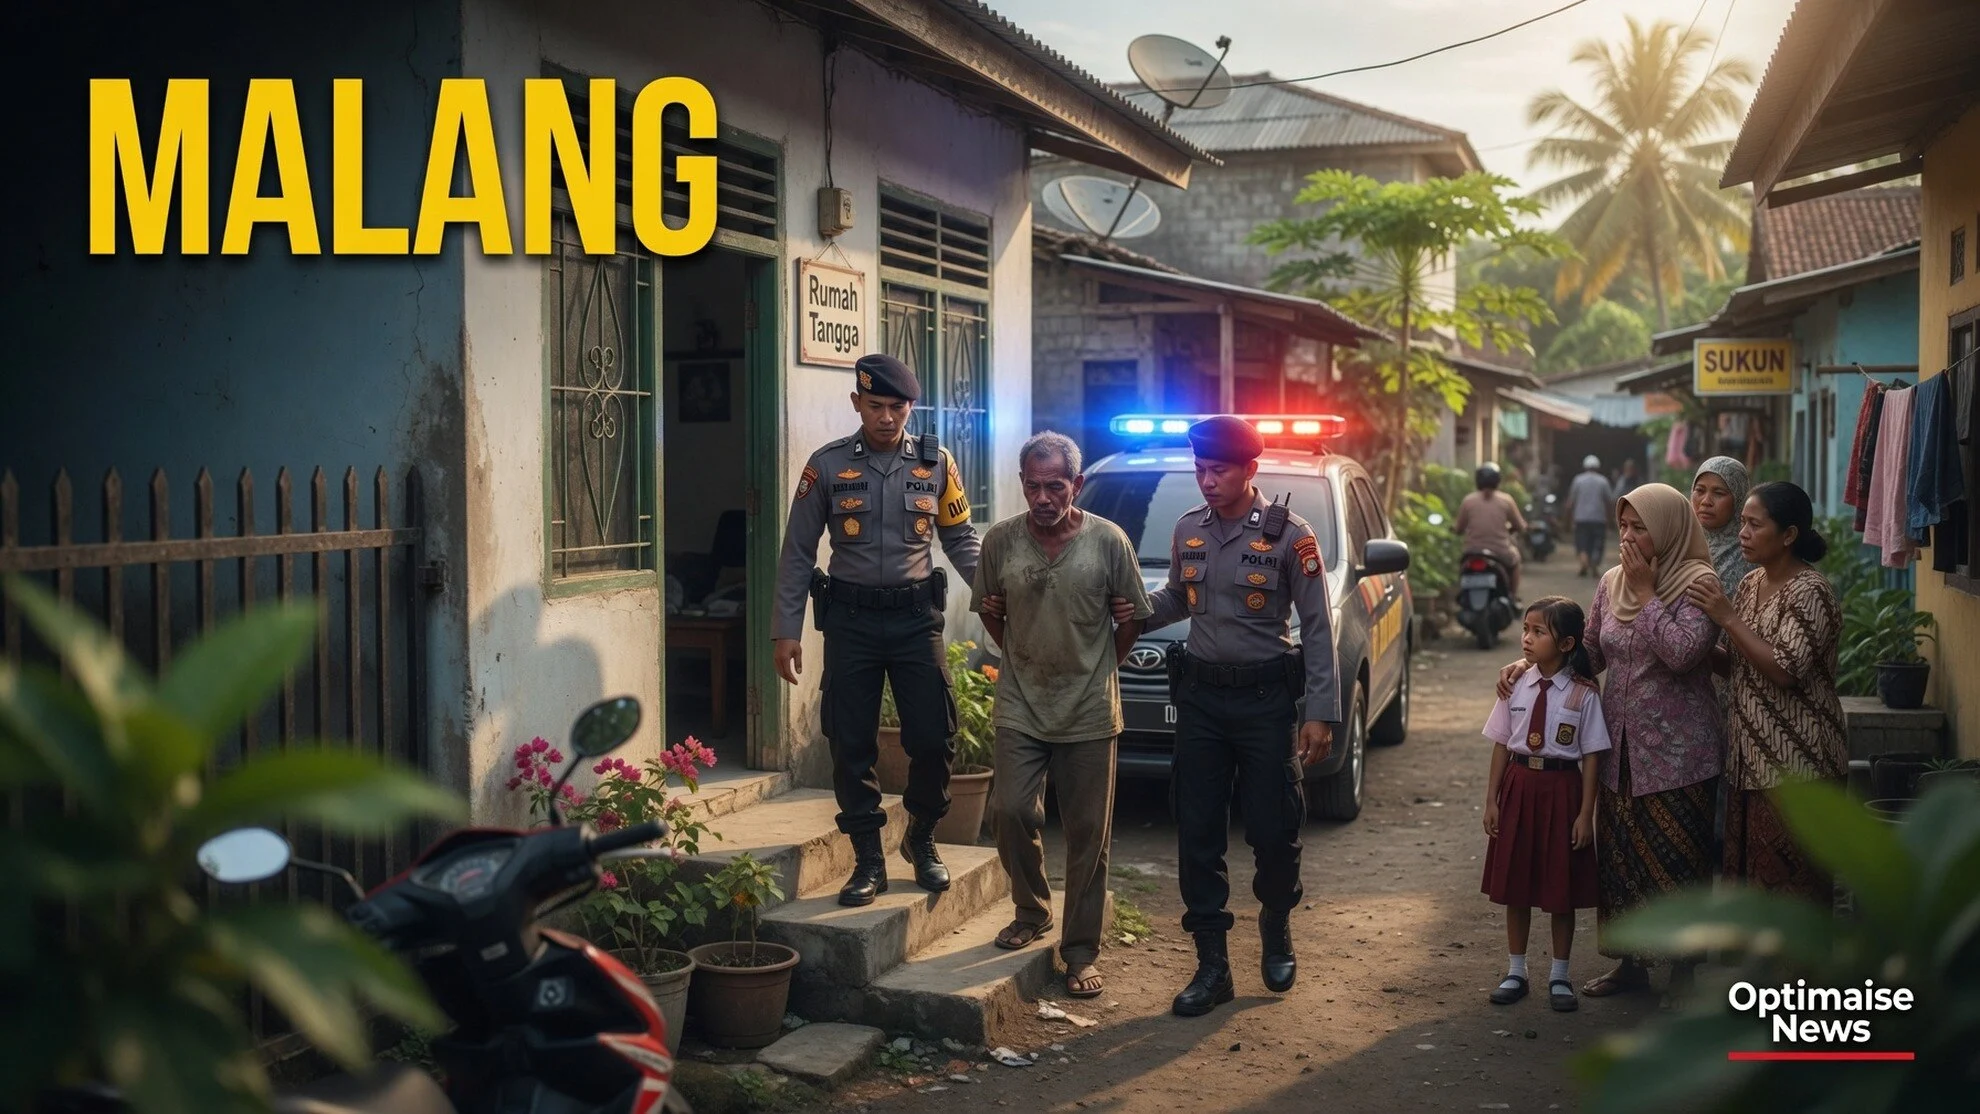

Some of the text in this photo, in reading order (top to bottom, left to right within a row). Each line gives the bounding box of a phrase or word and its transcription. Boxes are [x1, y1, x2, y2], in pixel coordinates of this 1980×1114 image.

[809, 274, 858, 312] Rumah
[809, 311, 859, 353] Tangga
[1704, 349, 1785, 373] SUKUN
